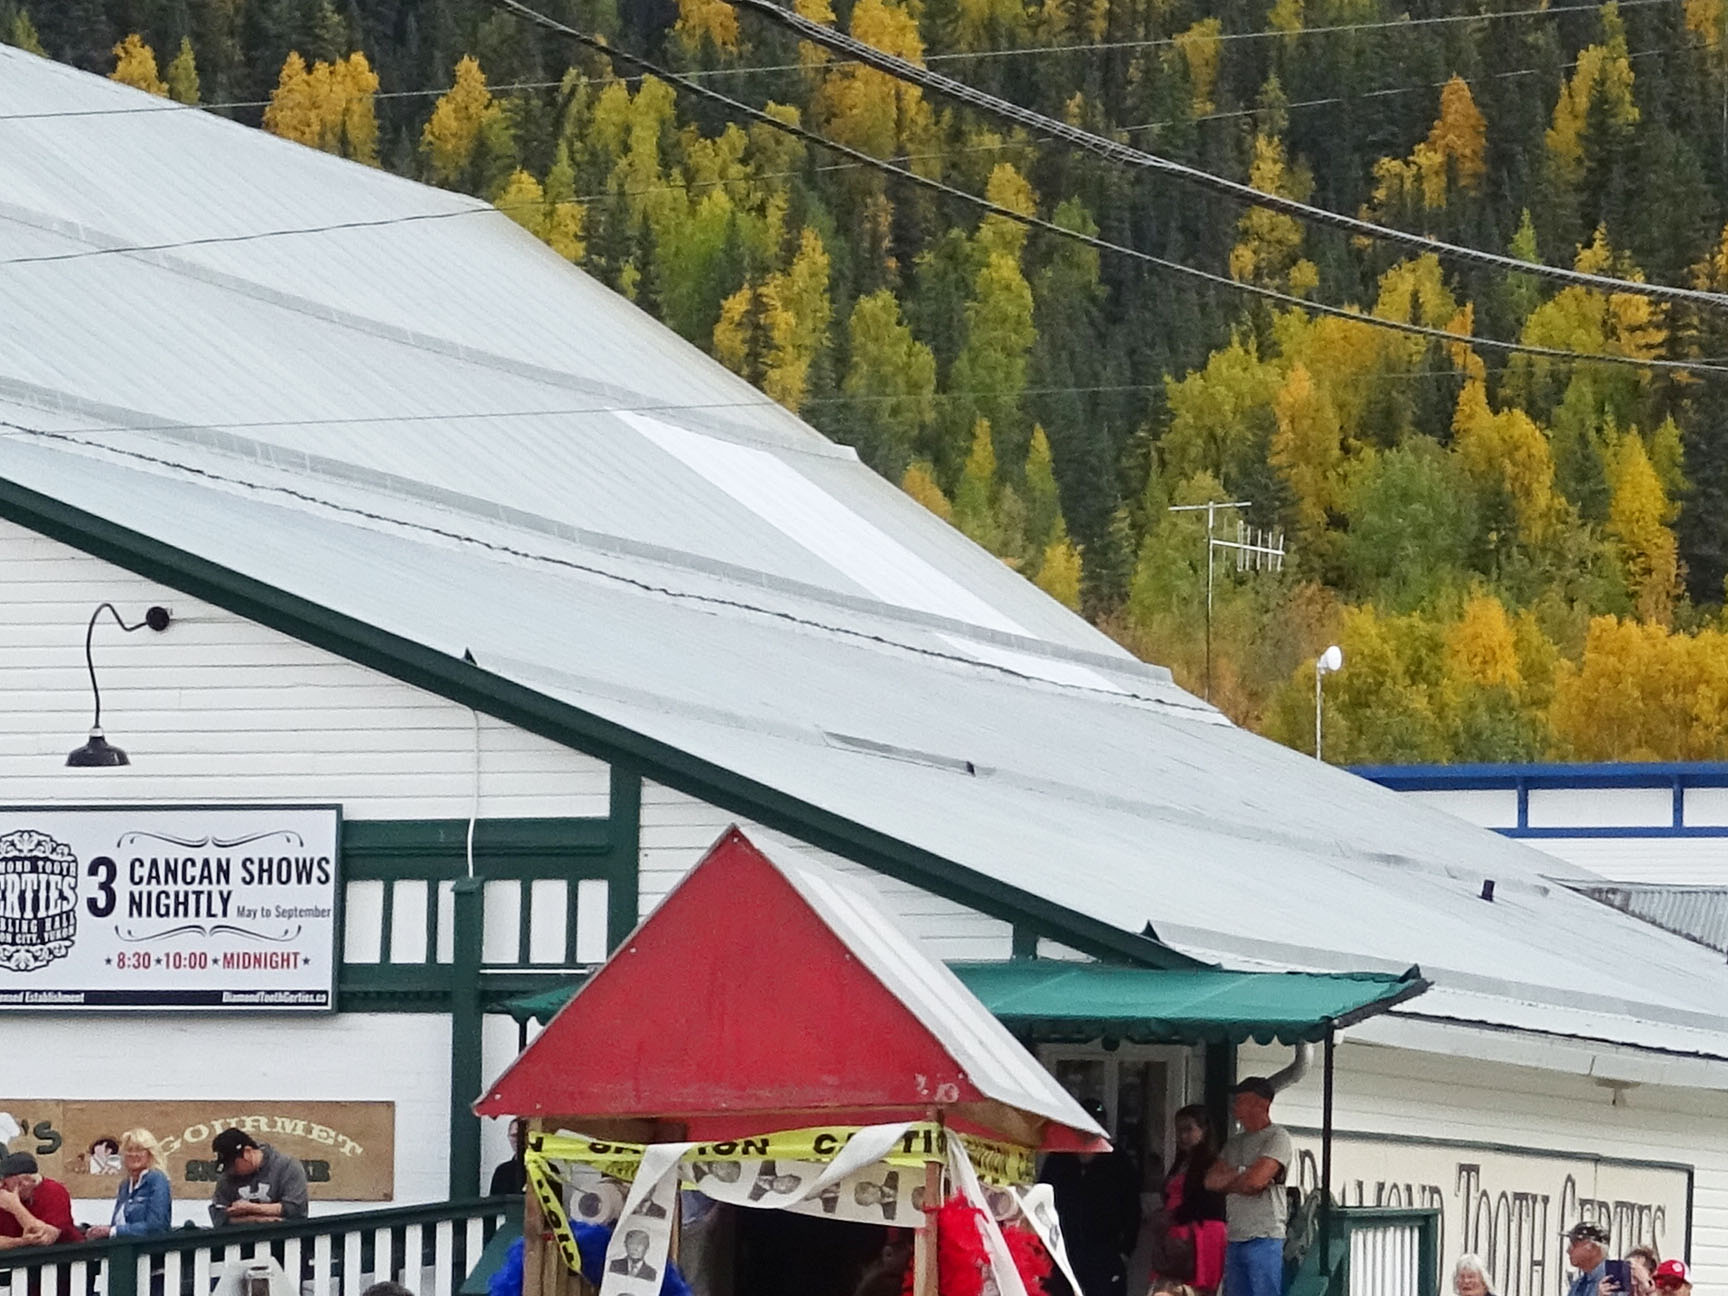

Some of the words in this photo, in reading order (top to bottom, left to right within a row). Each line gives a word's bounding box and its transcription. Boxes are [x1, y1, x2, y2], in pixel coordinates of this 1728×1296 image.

[86, 856, 117, 917] 3
[129, 857, 231, 886] CANCAN
[241, 857, 331, 886] SHOWS
[128, 890, 233, 918] NIGHTLY
[237, 905, 258, 920] May
[261, 905, 272, 917] to
[275, 905, 331, 920] September
[117, 952, 151, 970] 8:30
[165, 952, 208, 970] 10:00
[222, 951, 301, 970] MIDNIGHT
